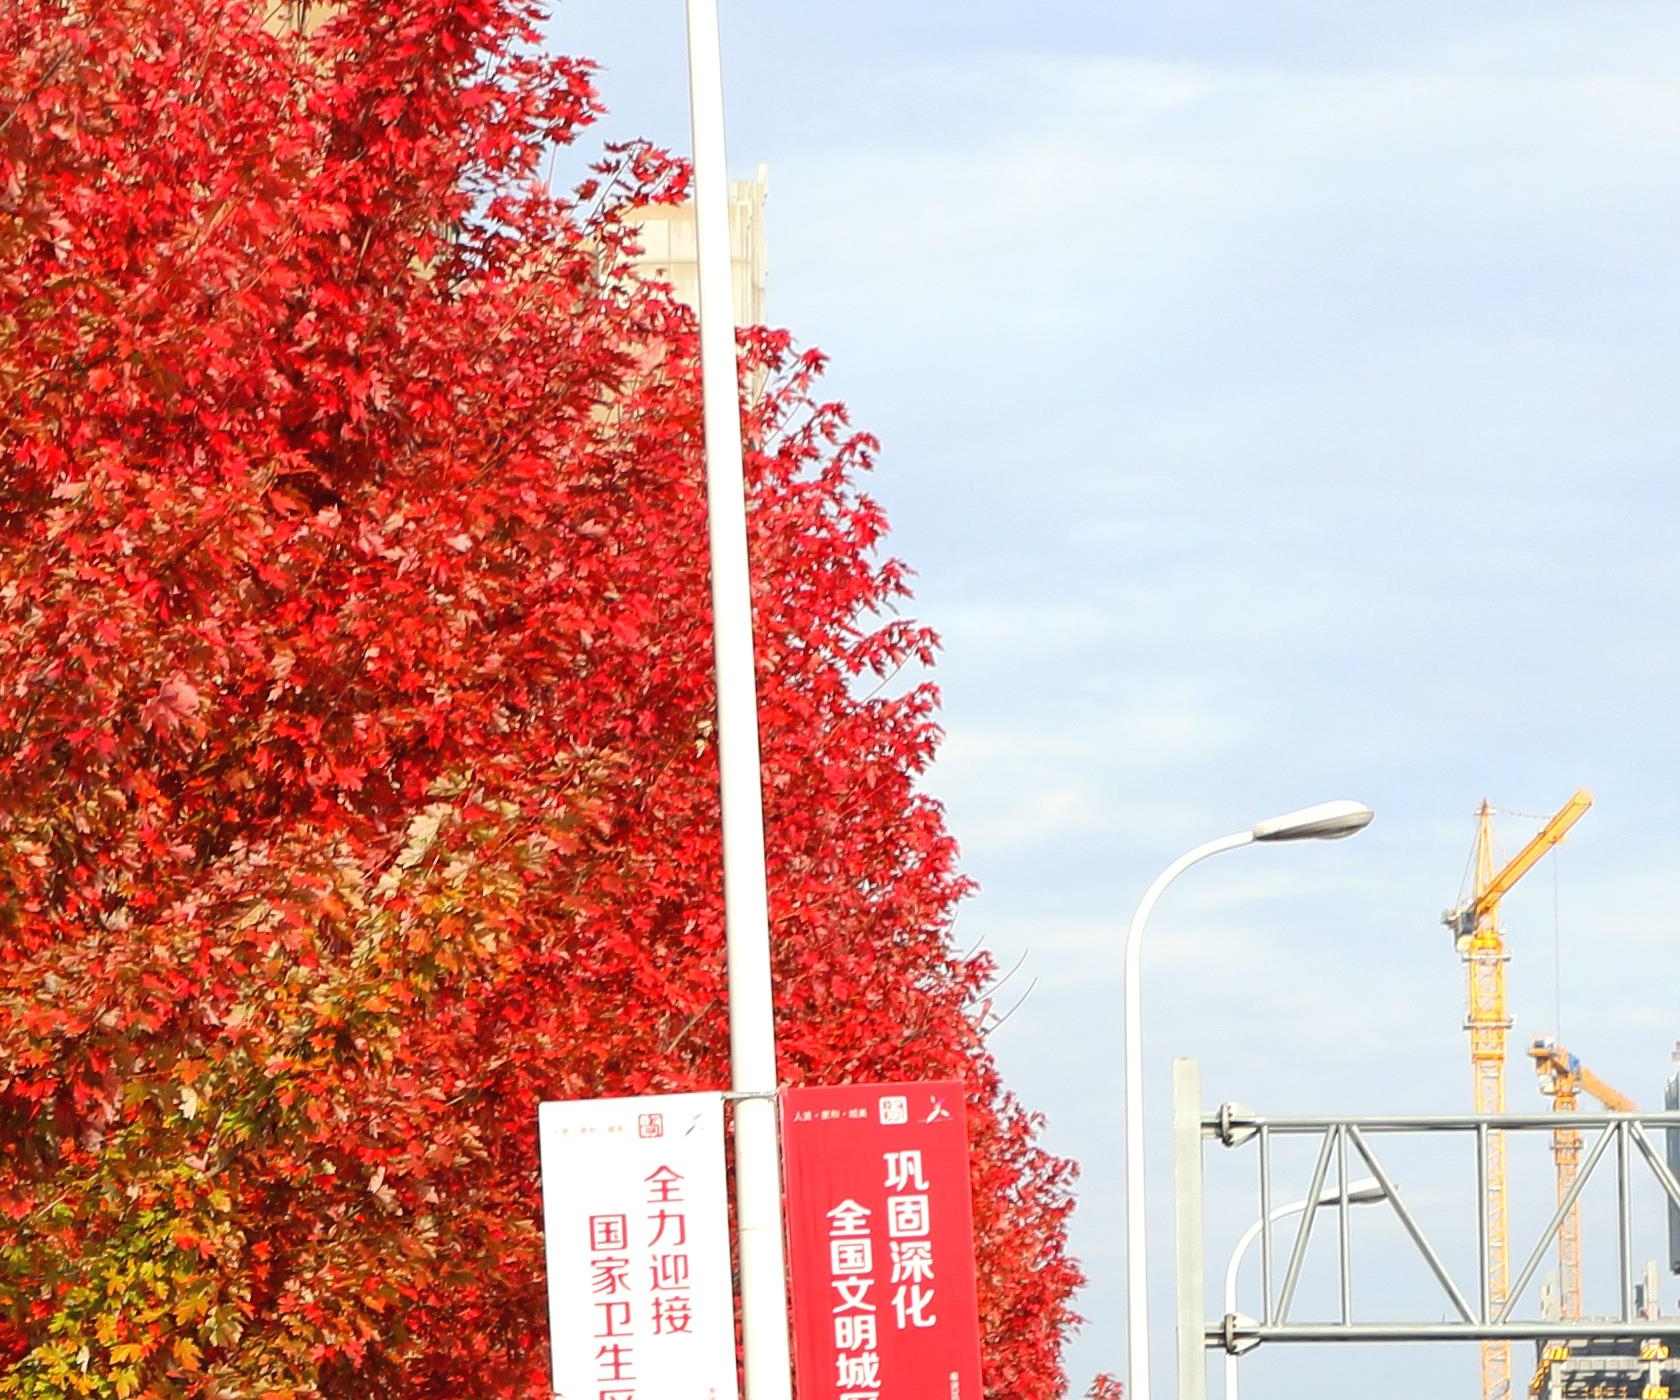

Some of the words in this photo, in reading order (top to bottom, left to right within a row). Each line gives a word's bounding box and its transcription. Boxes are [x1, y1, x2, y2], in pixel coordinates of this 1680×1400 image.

[643, 1165, 693, 1335] 全力迎接
[883, 1149, 937, 1330] 巩固深化
